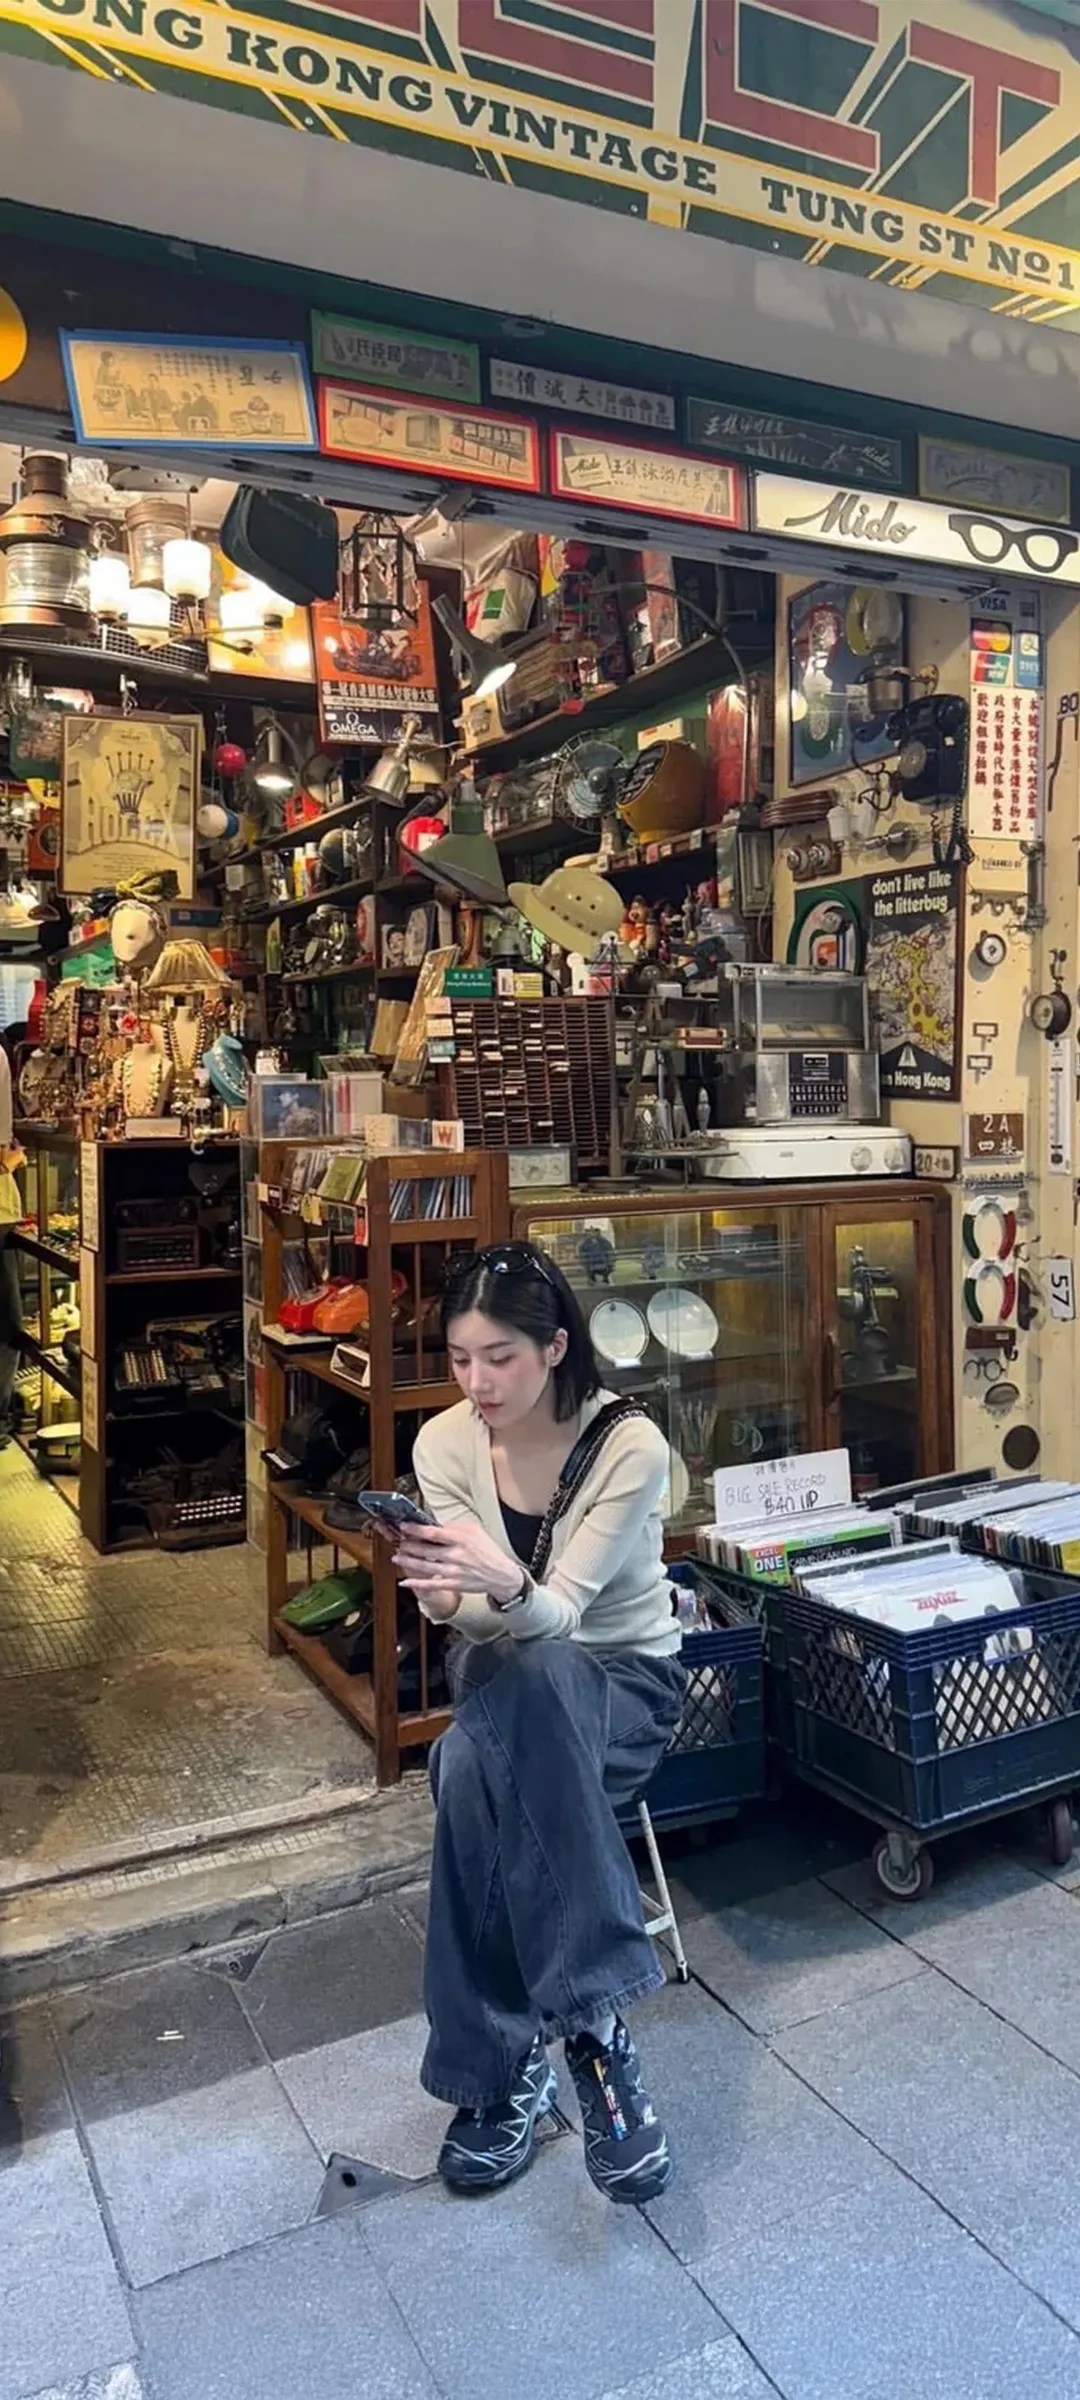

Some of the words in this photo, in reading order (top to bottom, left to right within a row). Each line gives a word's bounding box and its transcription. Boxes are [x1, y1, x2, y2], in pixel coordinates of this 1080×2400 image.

[226, 26, 433, 113] KONG
[445, 87, 717, 195] VINTAGE
[761, 177, 904, 243] TUNG
[919, 222, 975, 262] ST
[784, 491, 918, 544] Mido
[980, 596, 1007, 610] VISA
[330, 722, 377, 735] OMEGA
[873, 877, 901, 895] don't
[904, 873, 926, 892] live
[929, 871, 951, 888] like
[874, 900, 894, 916] the
[895, 894, 948, 916] litterbug
[894, 1070, 921, 1090] Hong
[922, 1072, 951, 1092] Kong
[1050, 1273, 1070, 1307] 57
[724, 1485, 750, 1506] BIG
[757, 1481, 781, 1500] SALE
[785, 1474, 826, 1493] RECORD
[800, 1490, 819, 1510] UP
[754, 1556, 786, 1573] ONE
